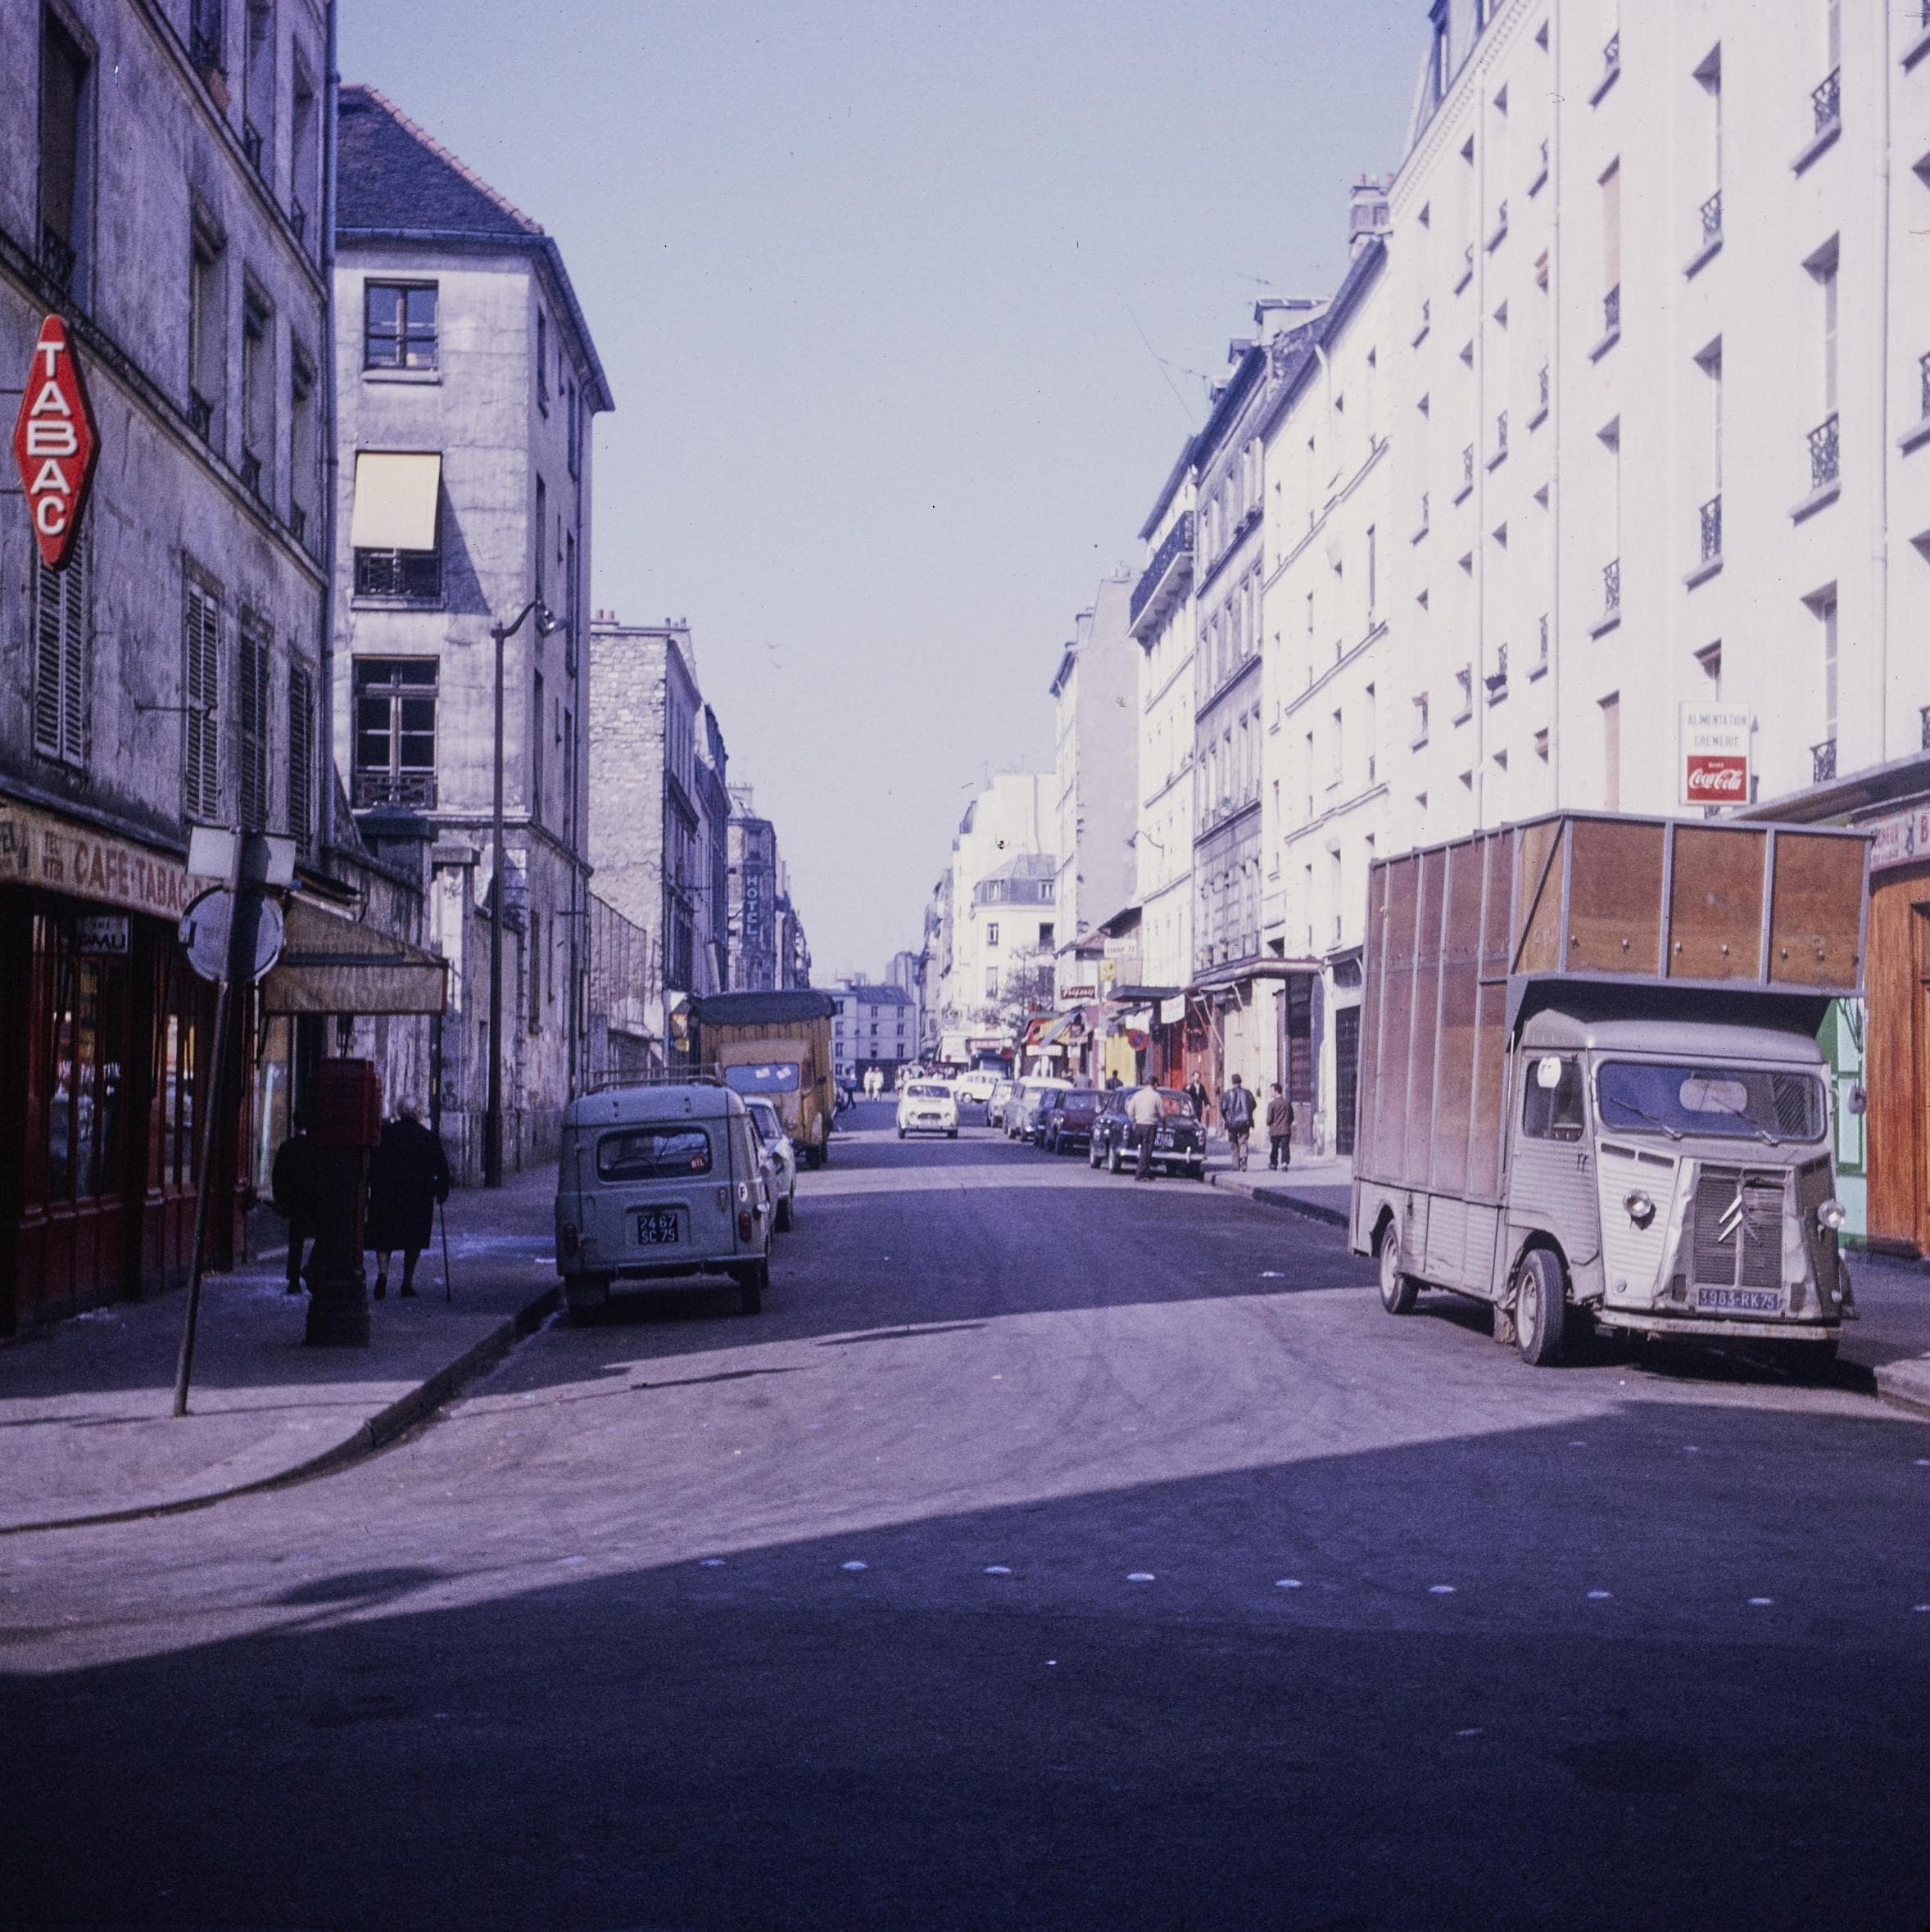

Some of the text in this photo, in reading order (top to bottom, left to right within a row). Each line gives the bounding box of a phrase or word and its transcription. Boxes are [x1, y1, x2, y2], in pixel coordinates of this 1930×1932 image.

[26, 341, 78, 536] TABAC
[1688, 713, 1747, 726] ALIMENTATION
[746, 875, 759, 935] HOTEL
